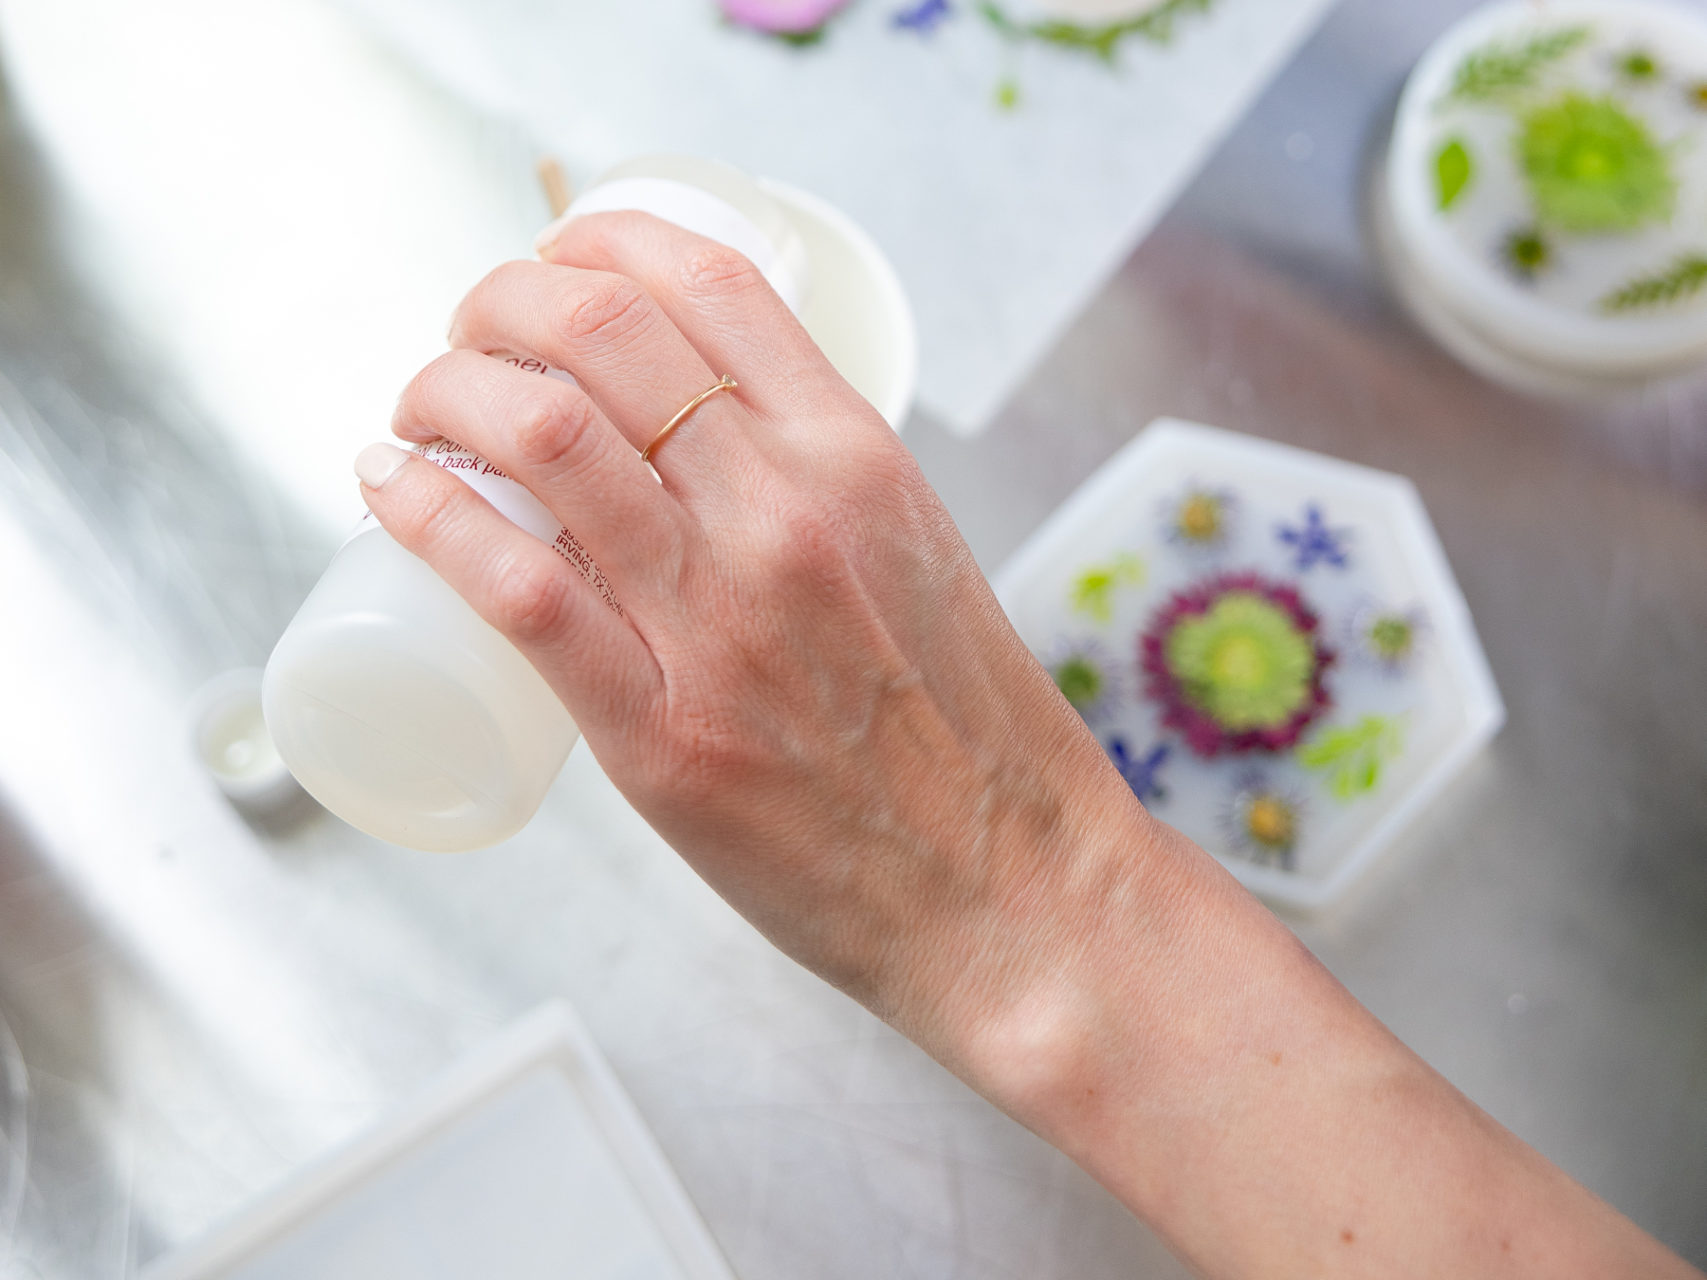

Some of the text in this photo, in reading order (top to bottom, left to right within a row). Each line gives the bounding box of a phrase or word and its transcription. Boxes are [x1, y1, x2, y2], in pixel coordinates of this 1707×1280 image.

[442, 456, 482, 470] back
[556, 535, 590, 577] IRVING,
[593, 573, 604, 592] TX
